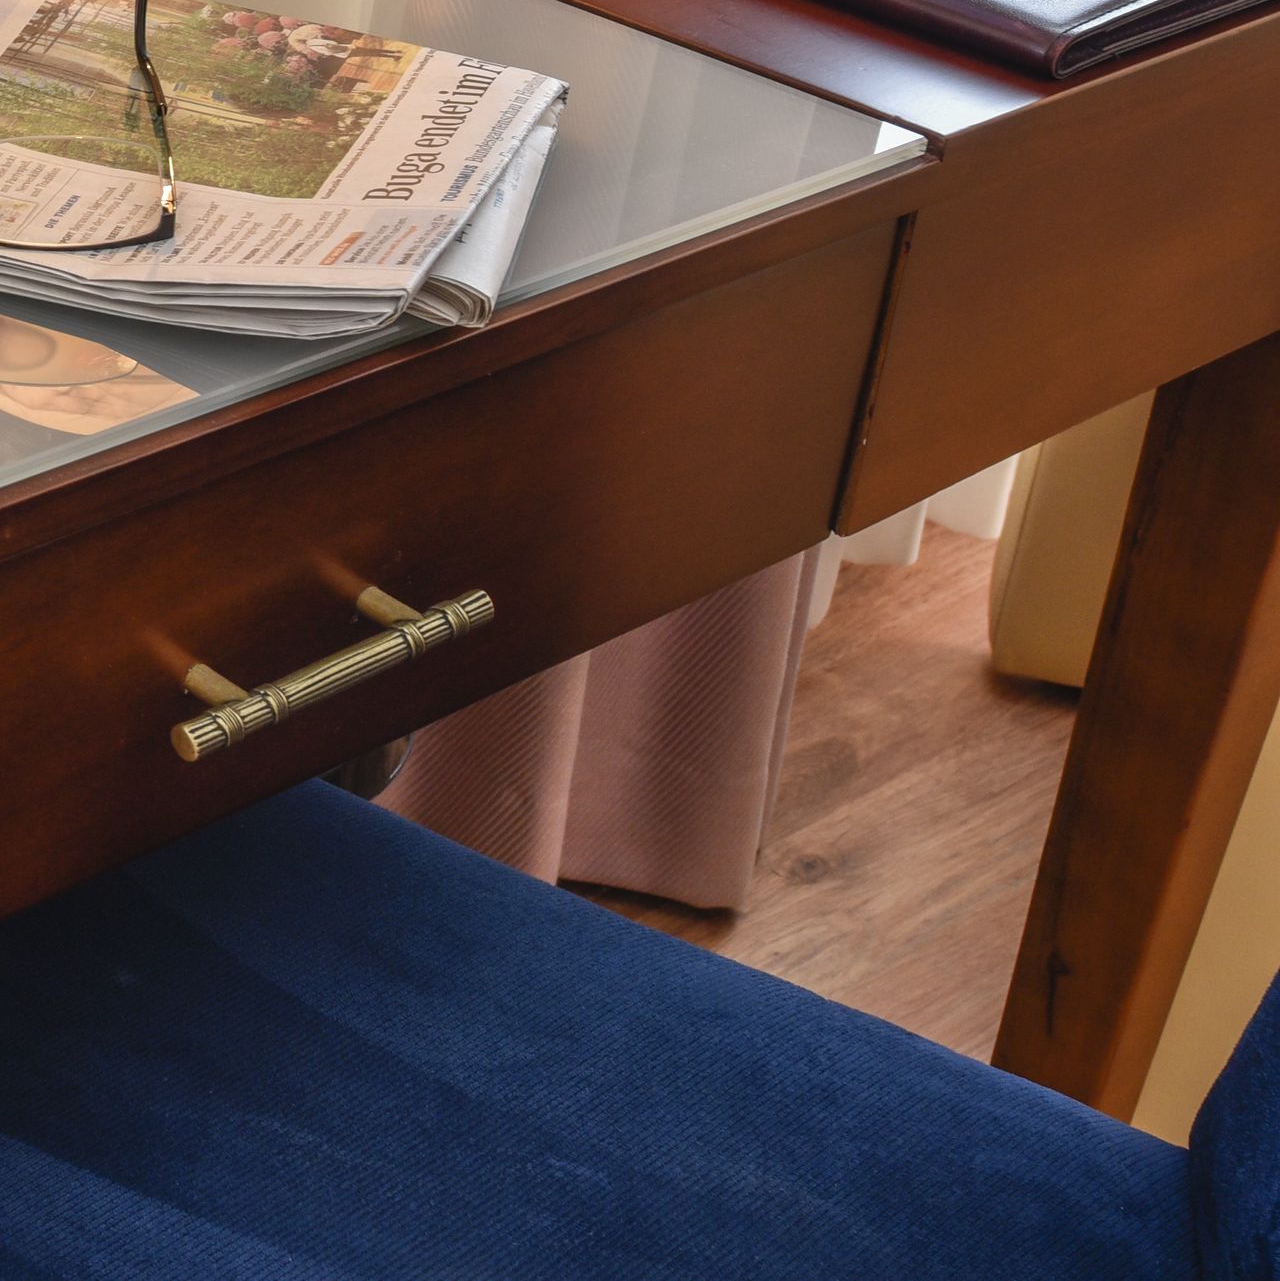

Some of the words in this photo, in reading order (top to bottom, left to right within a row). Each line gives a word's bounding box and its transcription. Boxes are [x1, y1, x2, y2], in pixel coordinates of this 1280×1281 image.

[438, 70, 494, 99] im
[415, 99, 479, 148] endet
[362, 152, 445, 201] Buga
[441, 164, 478, 203] TOURISMUS
[468, 105, 520, 163] Bundesgartenschau
[44, 215, 57, 229] DIE
[55, 194, 81, 220] THEMEN
